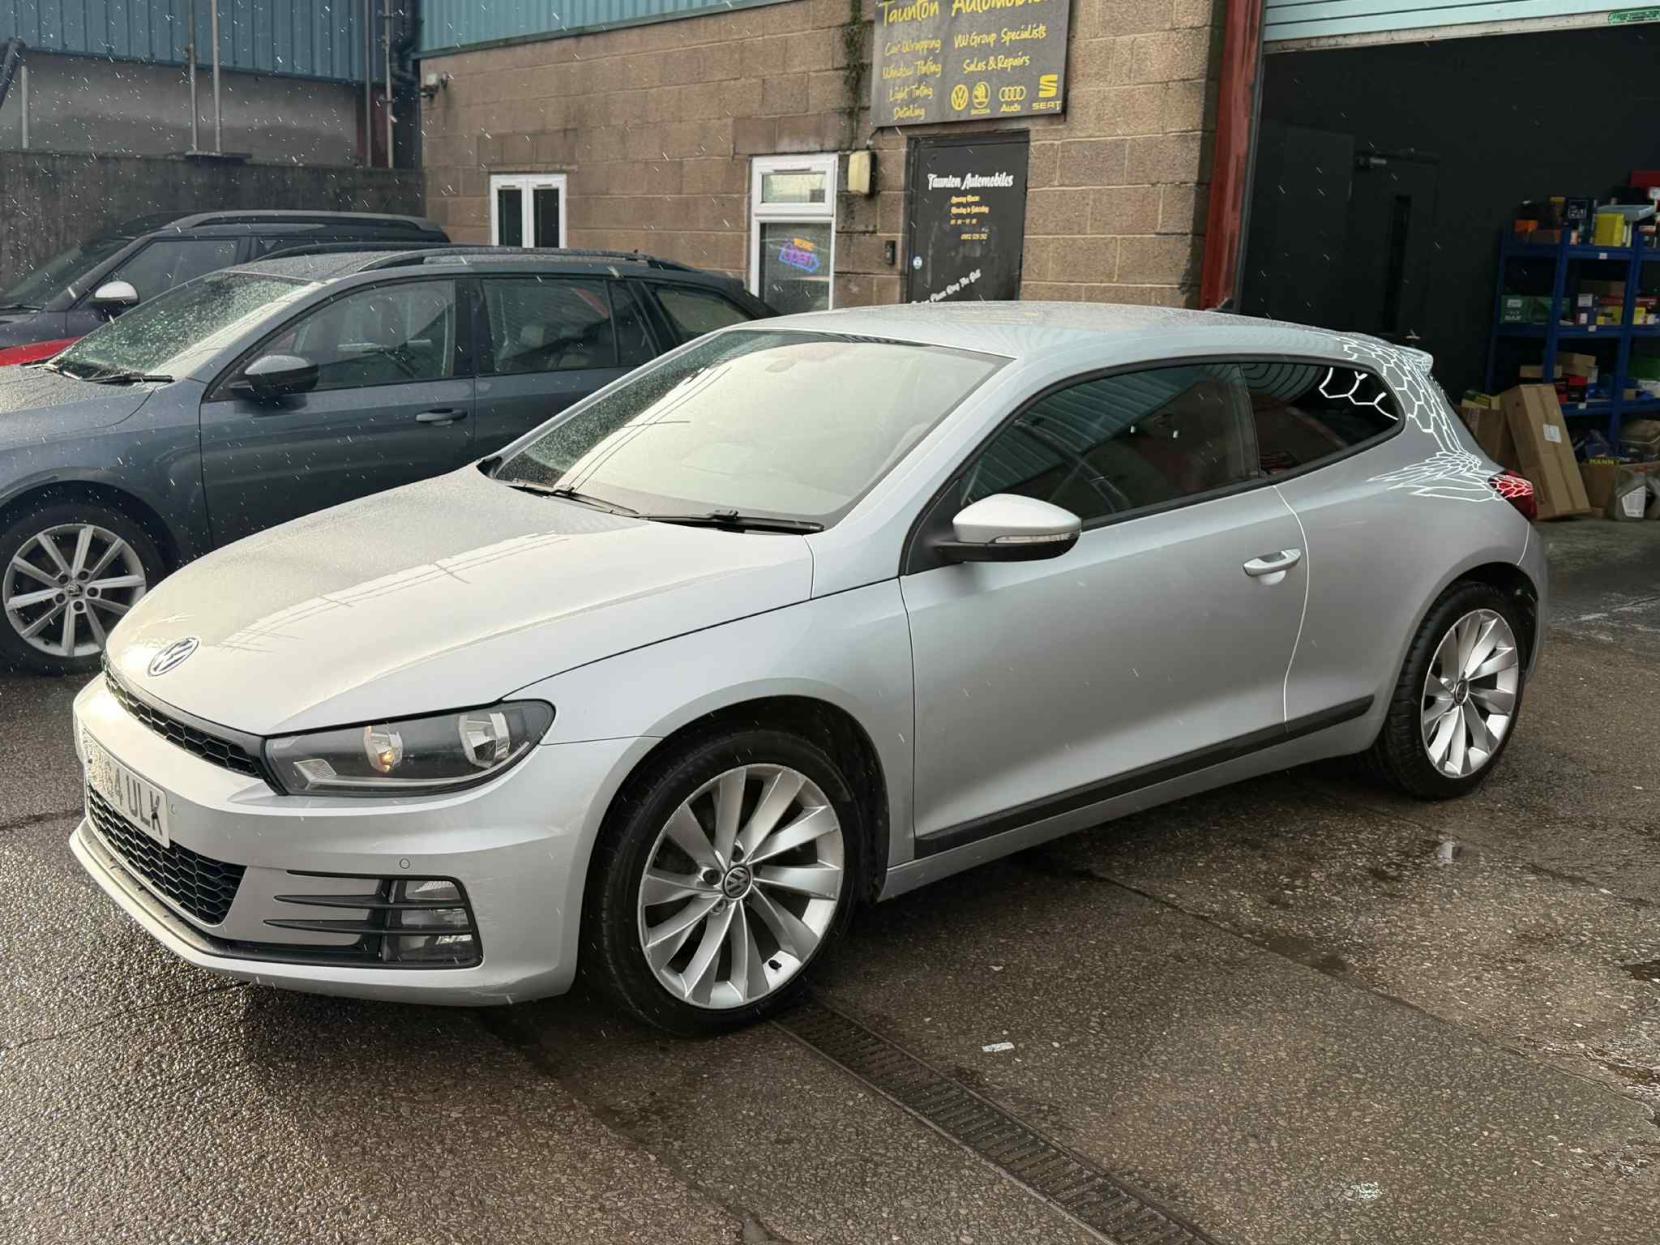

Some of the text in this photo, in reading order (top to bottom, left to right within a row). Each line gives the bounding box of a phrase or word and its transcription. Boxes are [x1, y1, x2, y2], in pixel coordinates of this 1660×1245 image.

[878, 0, 939, 27] Taunton
[970, 31, 997, 47] Group
[1001, 23, 1047, 46] Specialists
[963, 51, 1030, 74] Sales & Repairs
[1000, 103, 1022, 112] Audi
[1032, 100, 1062, 110] SEAT
[927, 171, 1014, 190] Taunton Automobiles
